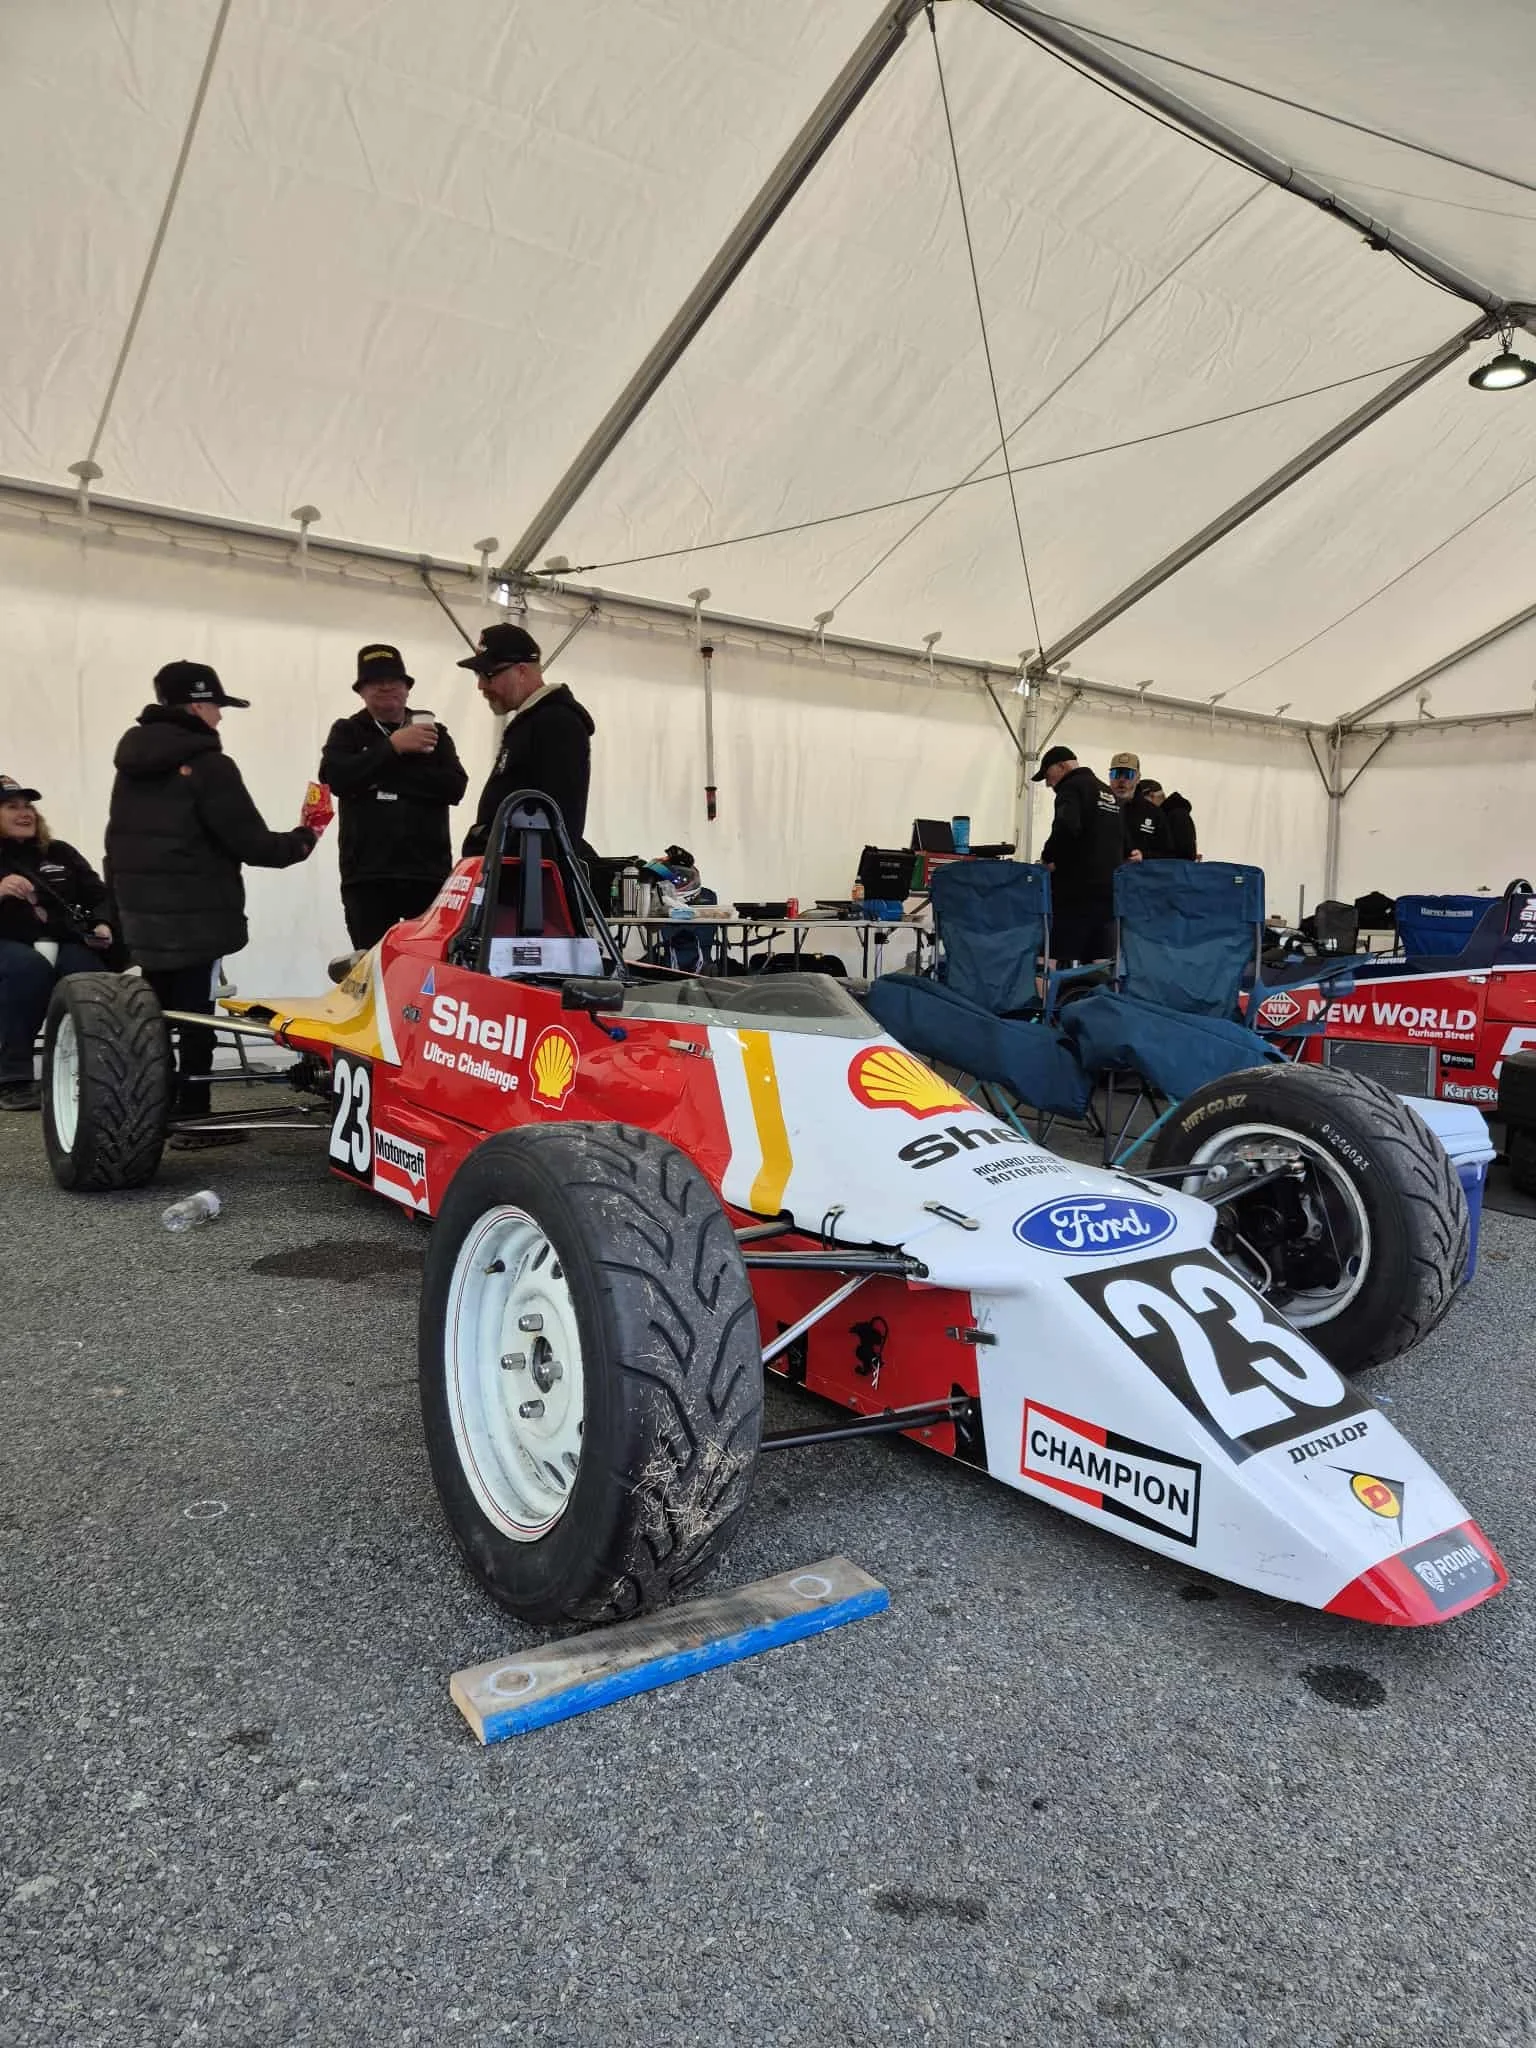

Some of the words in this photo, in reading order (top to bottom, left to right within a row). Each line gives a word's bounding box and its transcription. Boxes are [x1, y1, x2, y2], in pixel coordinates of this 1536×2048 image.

[428, 995, 528, 1060] Shell
[1267, 1002, 1291, 1014] NW
[1307, 1000, 1367, 1024] NEW
[1372, 1002, 1477, 1031] WORLD
[1407, 1028, 1443, 1039] Durham
[1444, 1030, 1475, 1041] Street
[422, 1040, 455, 1068] Ultra
[458, 1052, 519, 1093] Challenge
[329, 1058, 371, 1173] 23
[375, 1132, 425, 1178] Motorcraft
[898, 1126, 1029, 1170] She
[973, 1157, 1025, 1177] RICHARD
[1049, 1202, 1150, 1249] Ford
[1103, 1263, 1346, 1441] 23
[1287, 1420, 1369, 1465] DUNLOP
[1030, 1429, 1190, 1517] CHAMPION
[1433, 1544, 1481, 1577] RODIN
